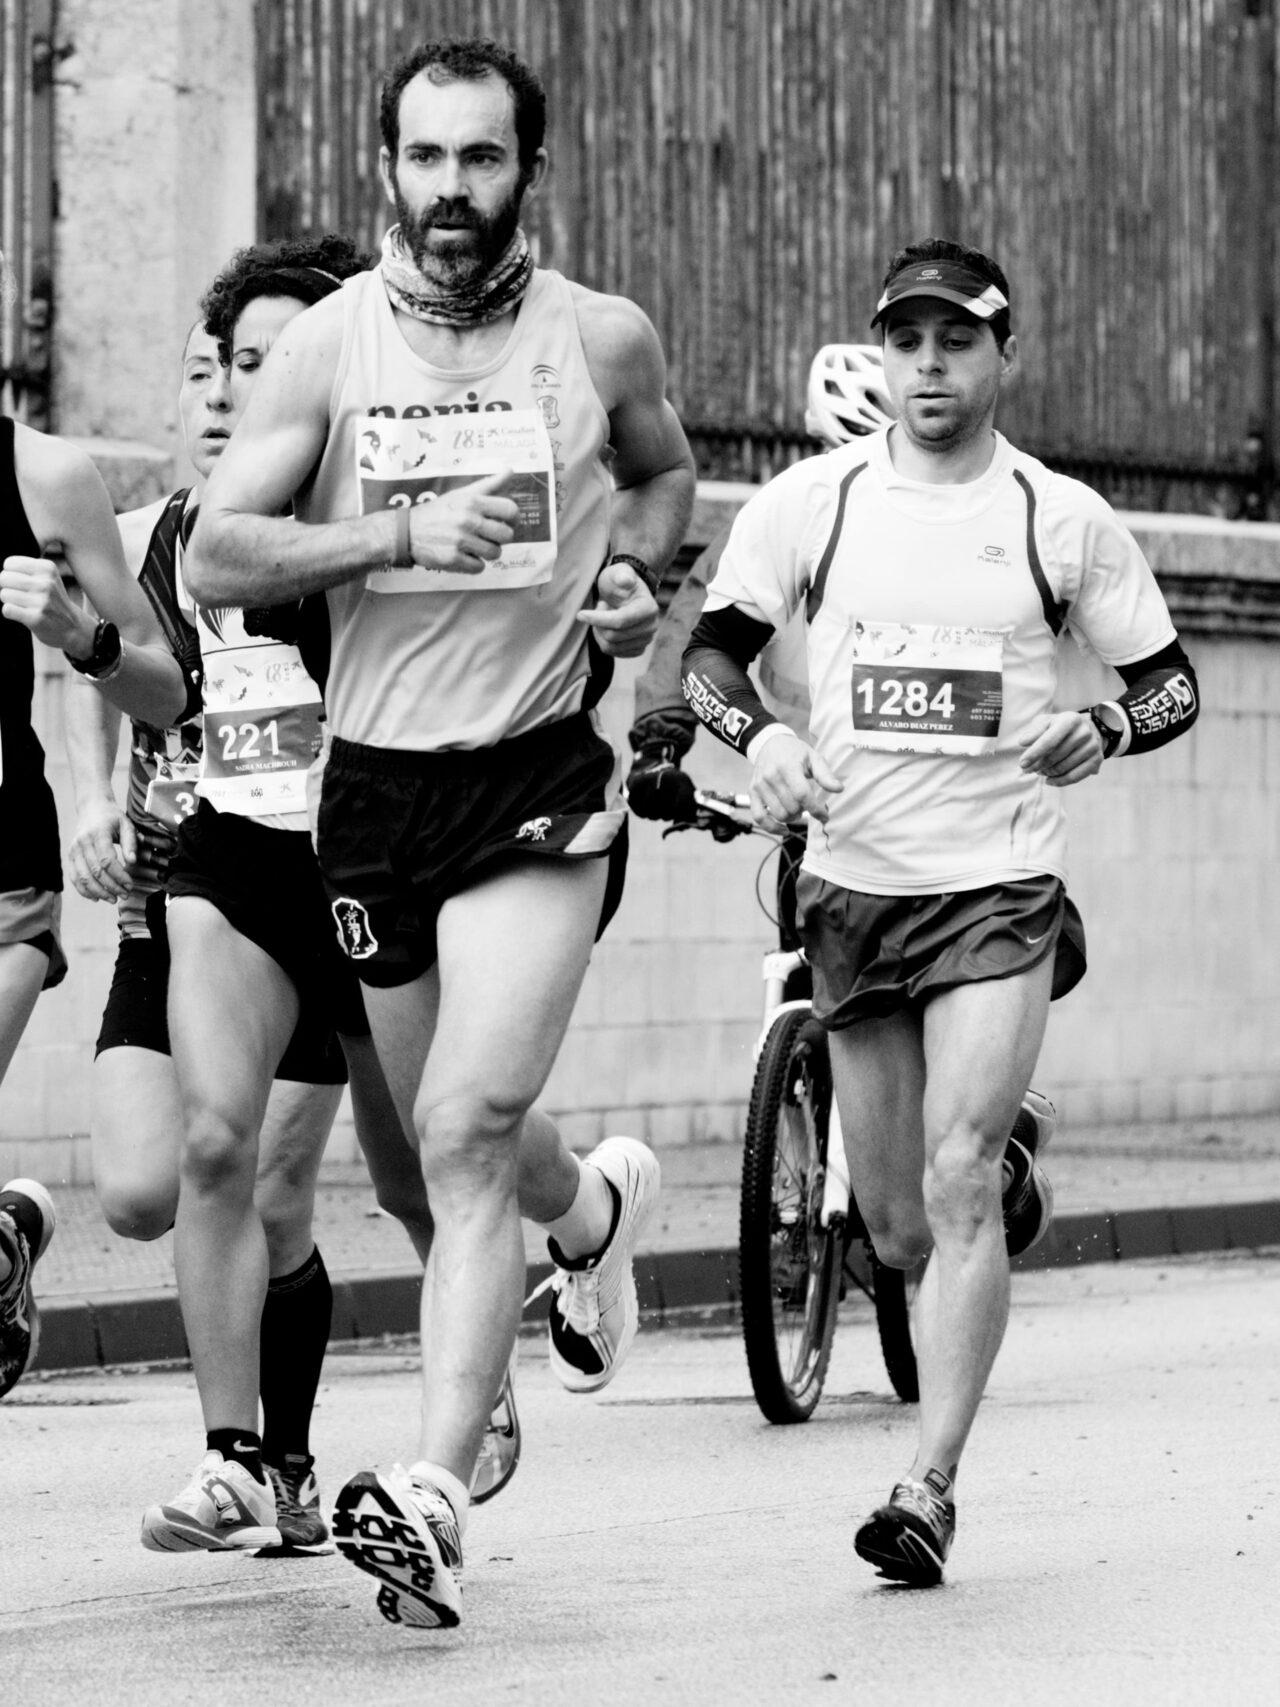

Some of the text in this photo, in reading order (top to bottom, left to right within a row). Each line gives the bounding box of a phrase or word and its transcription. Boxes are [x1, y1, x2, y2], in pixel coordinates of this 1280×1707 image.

[856, 678, 956, 718] 1284
[218, 719, 280, 761] 221
[879, 720, 909, 729] ALVARO
[929, 723, 954, 731] PEREZ
